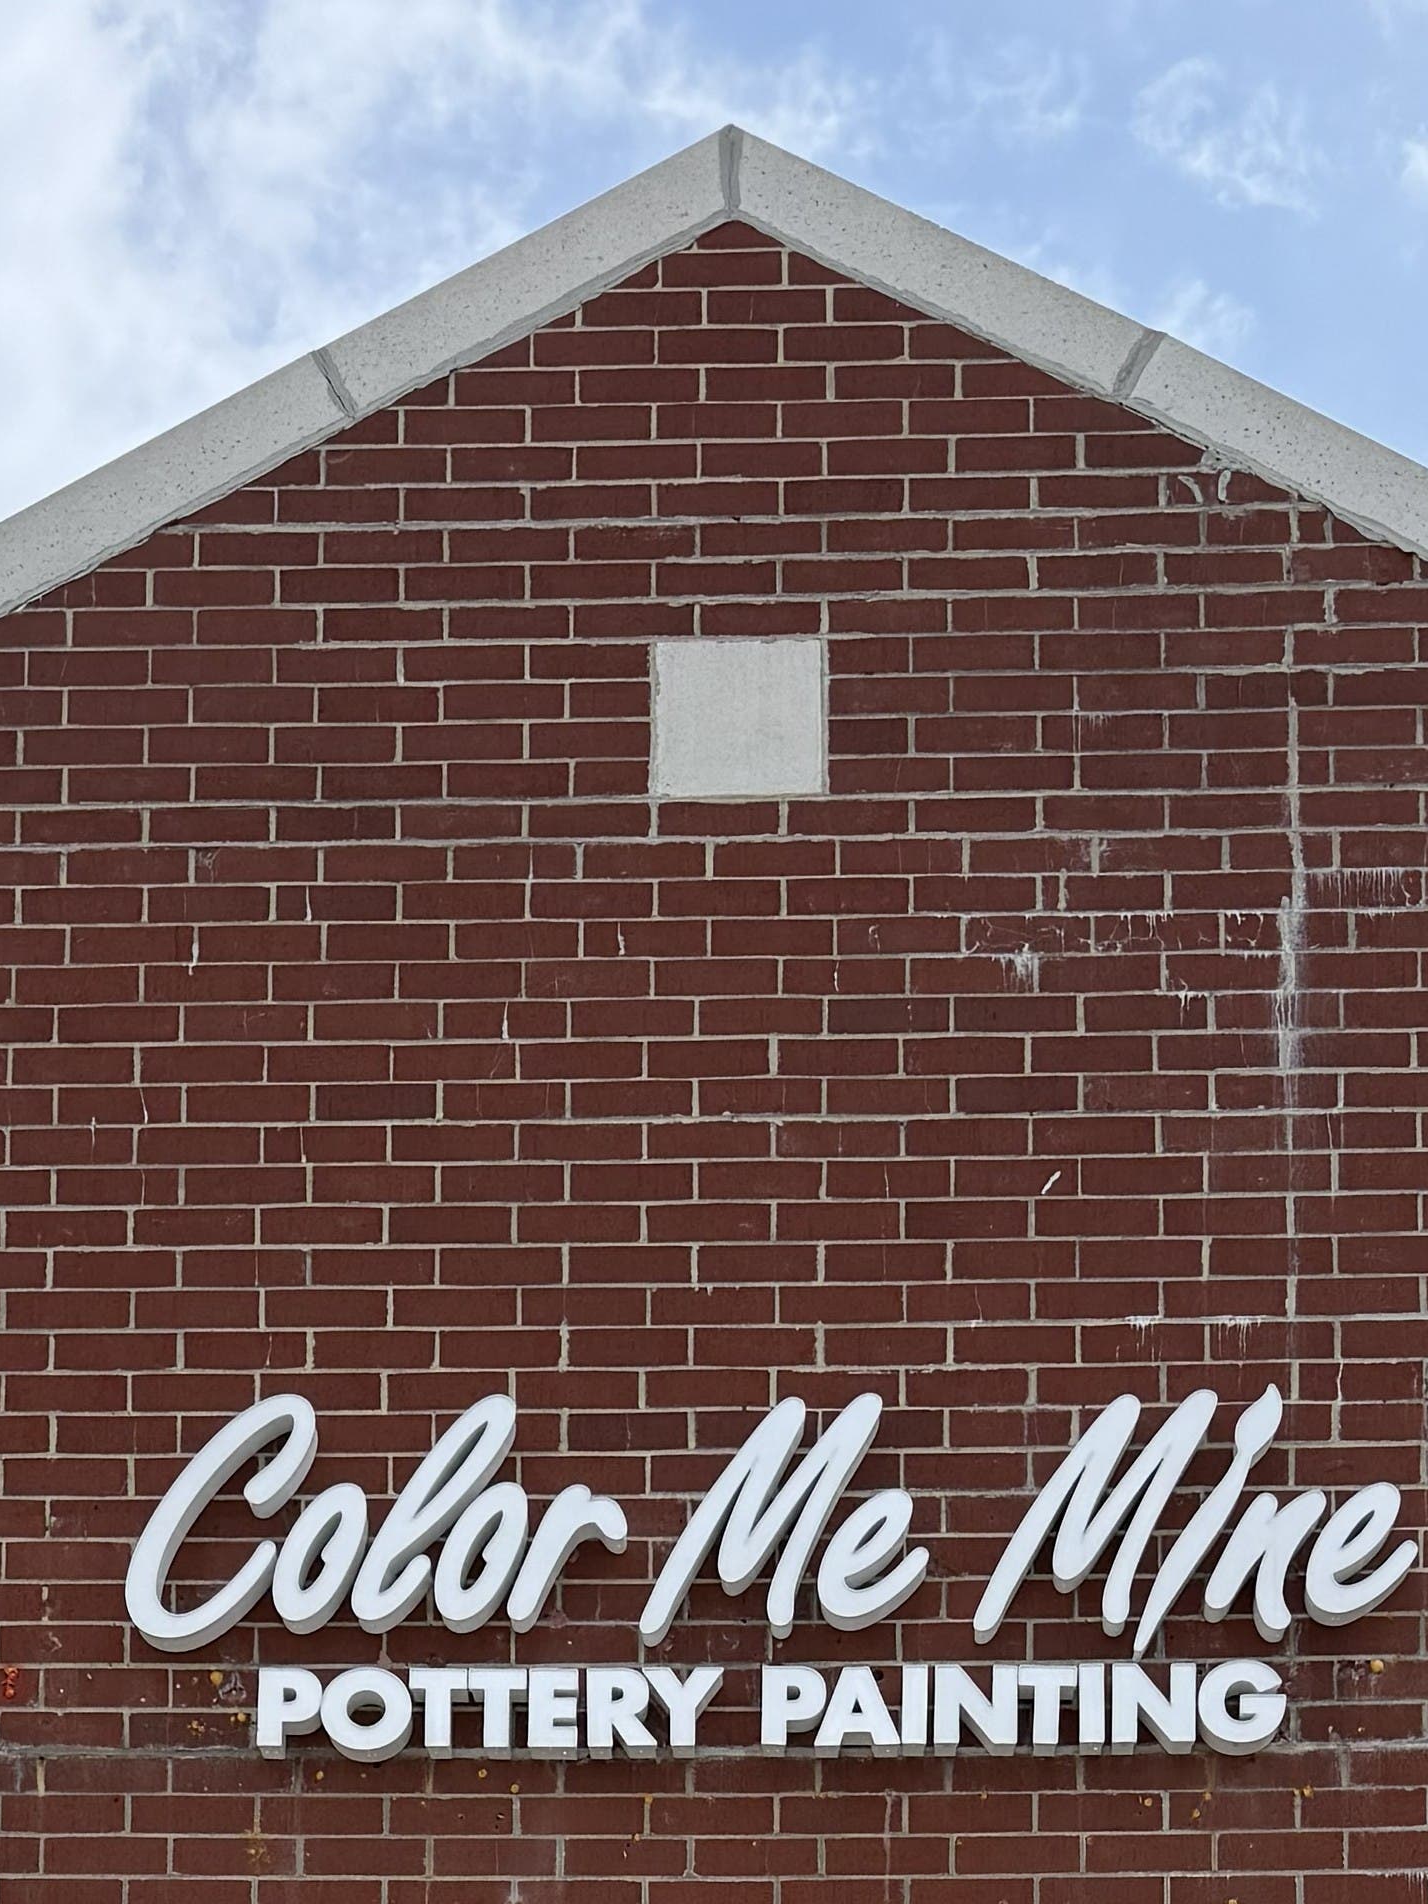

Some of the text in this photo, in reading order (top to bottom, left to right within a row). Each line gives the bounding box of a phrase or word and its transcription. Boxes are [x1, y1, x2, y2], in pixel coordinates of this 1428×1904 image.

[125, 1383, 1419, 1660] Color Me Mine
[255, 1658, 1288, 1761] POTTERY PAINTING
